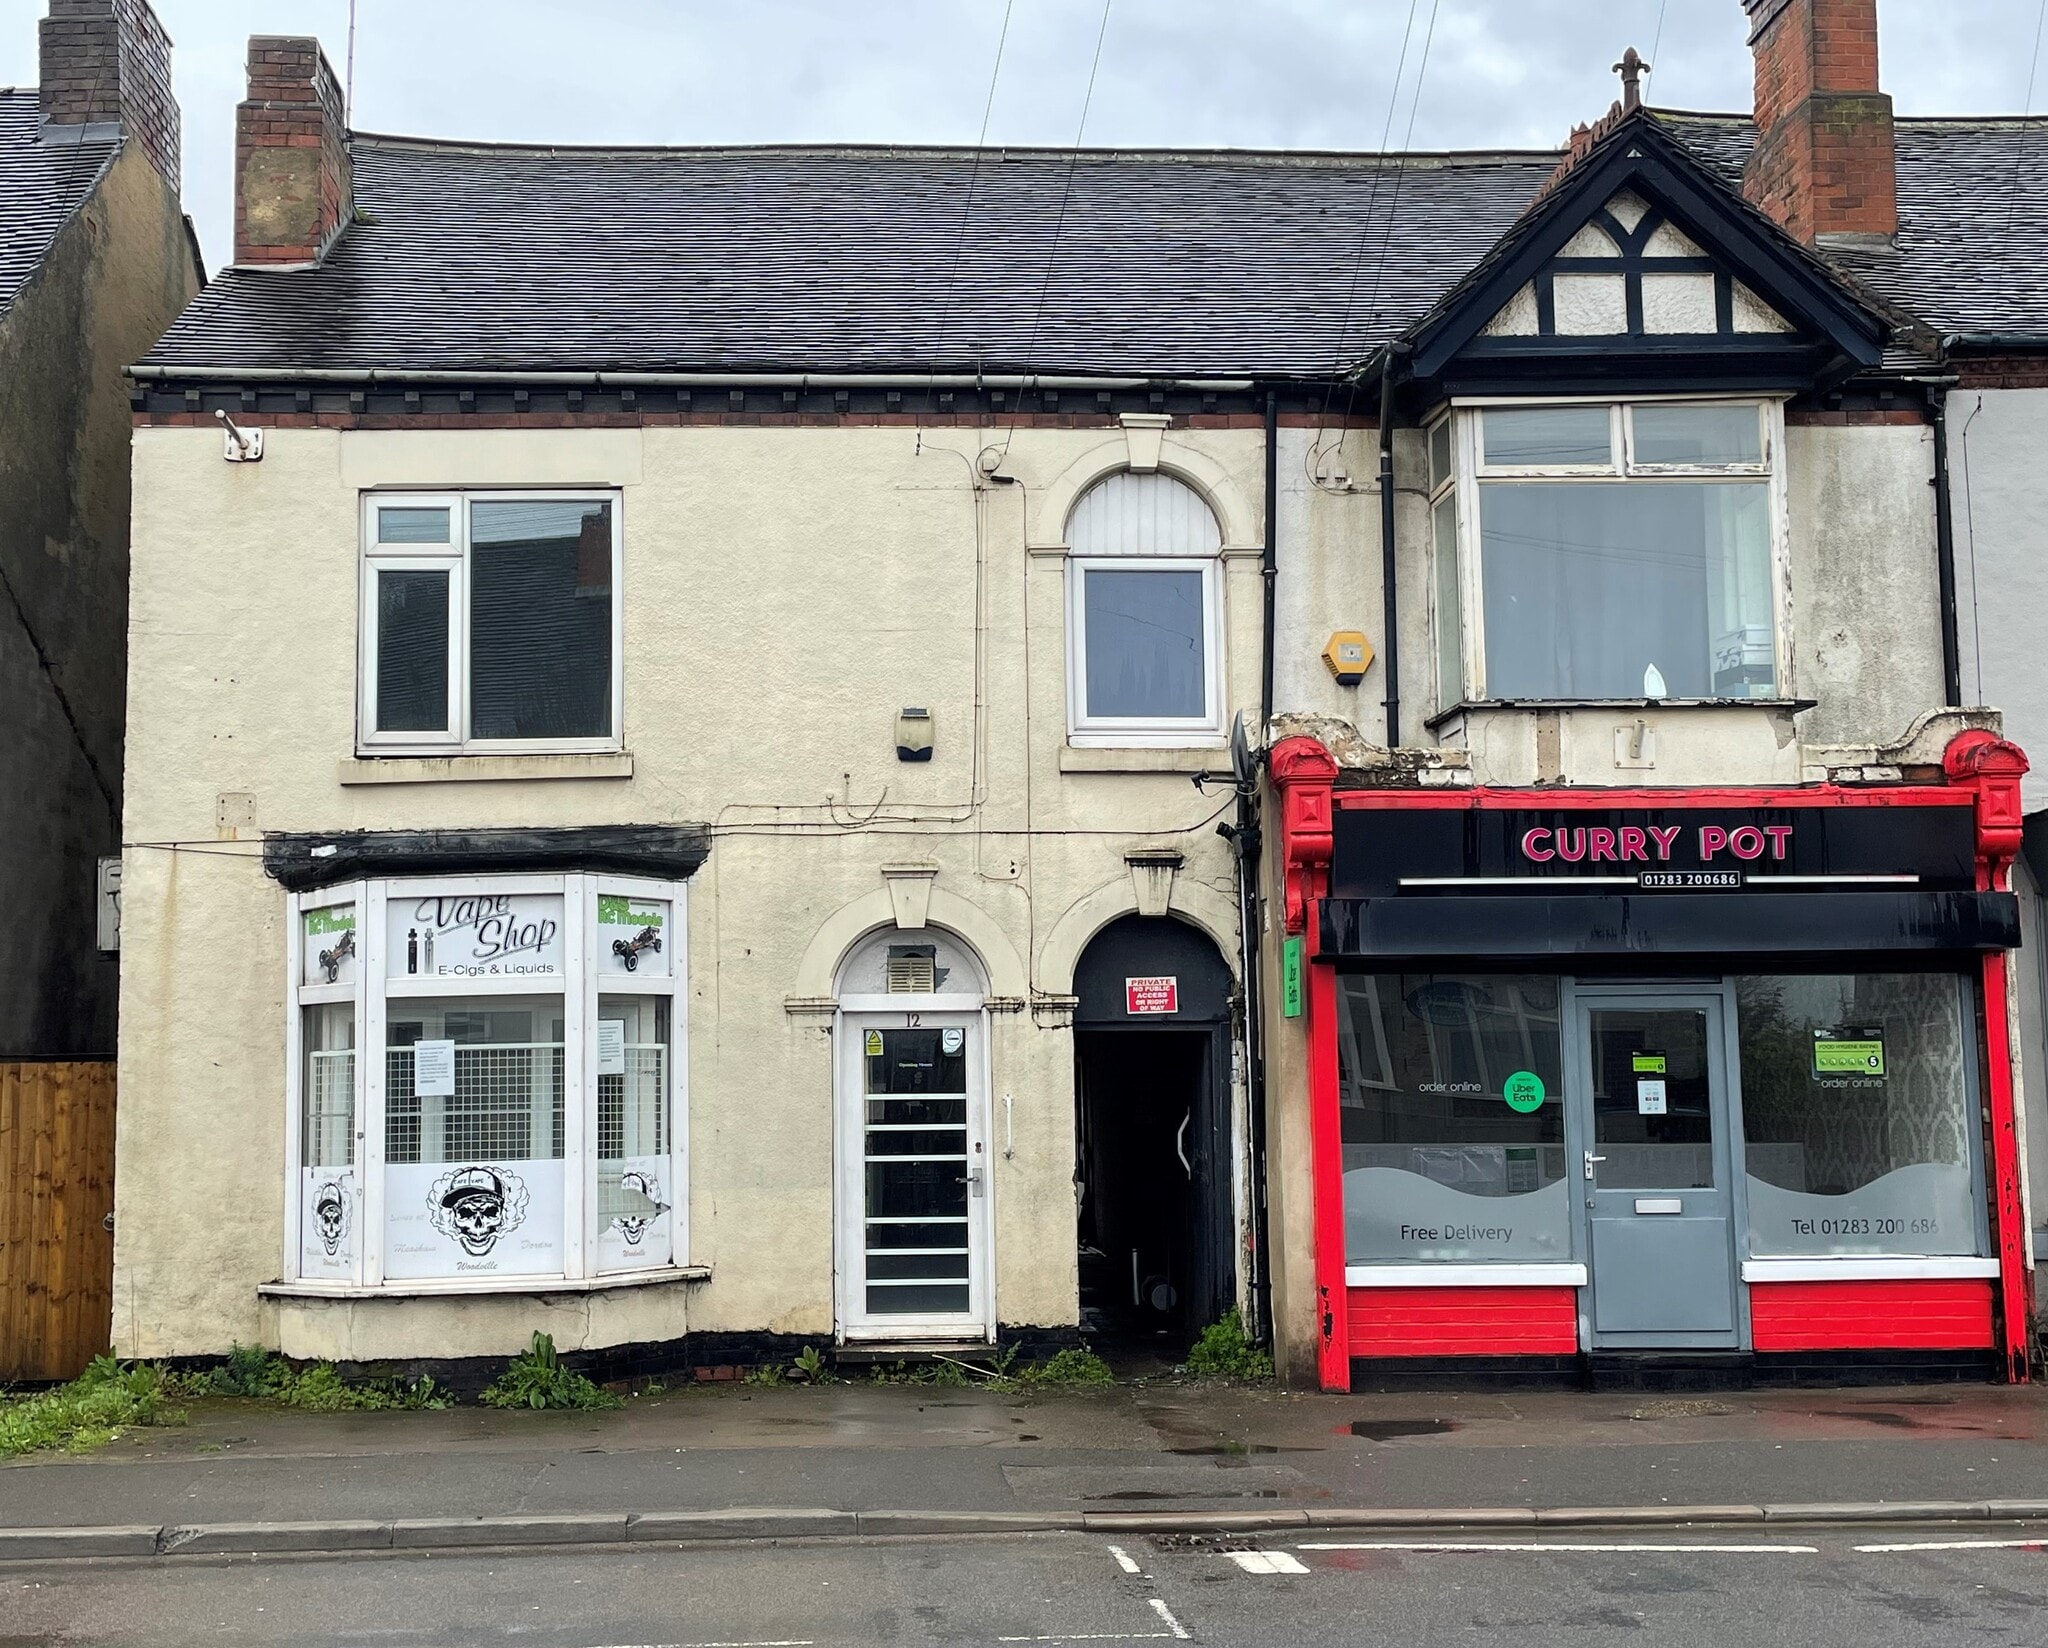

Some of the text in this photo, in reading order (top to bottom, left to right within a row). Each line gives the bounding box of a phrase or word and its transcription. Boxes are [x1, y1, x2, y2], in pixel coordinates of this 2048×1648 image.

[1521, 825, 1793, 862] CURRY POT
[1644, 874, 1736, 885] 01283 200686
[415, 894, 511, 929] Vape
[598, 909, 664, 927] RC Models
[472, 914, 557, 958] Shop
[438, 963, 554, 976] E-Cigs & Liquids
[905, 1012, 922, 1028] 12
[1870, 1056, 1877, 1067] 5
[1418, 1081, 1482, 1092] order online
[1512, 1083, 1535, 1093] Uber
[1821, 1078, 1883, 1088] order online
[1513, 1093, 1536, 1102] Eats
[1791, 1219, 1940, 1235] Tel 01283 200 686
[1400, 1224, 1513, 1244] Free Delivery
[456, 1260, 499, 1271] Woodville
